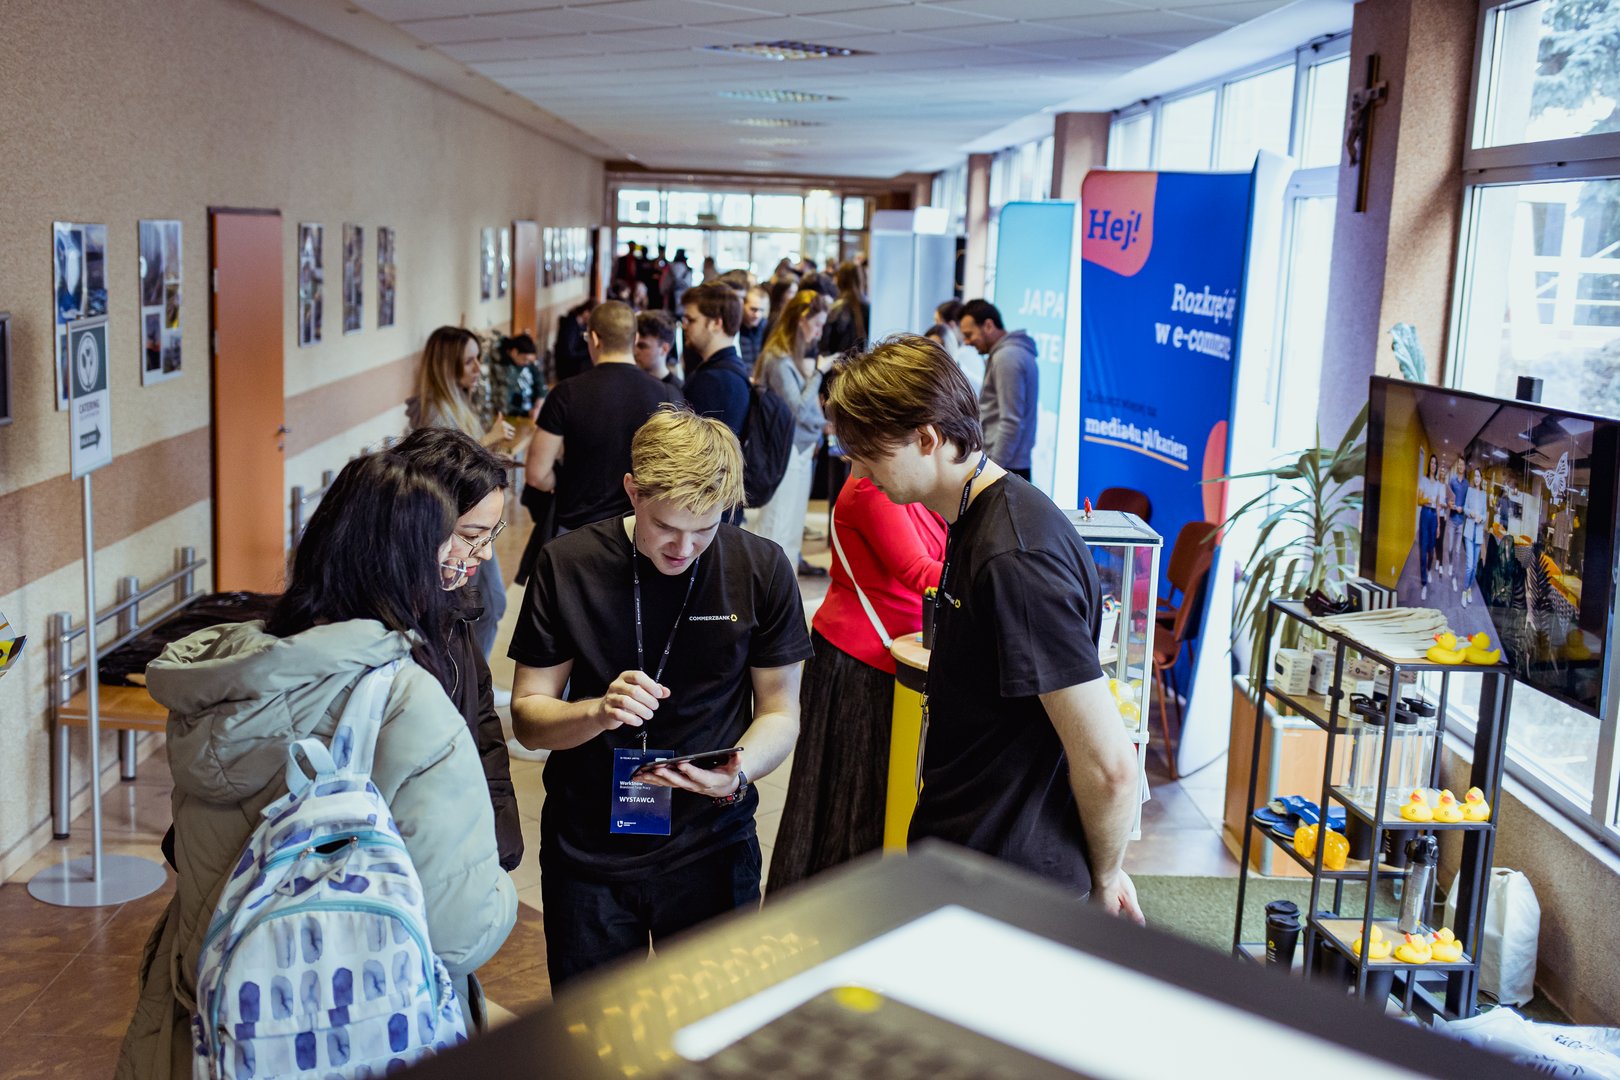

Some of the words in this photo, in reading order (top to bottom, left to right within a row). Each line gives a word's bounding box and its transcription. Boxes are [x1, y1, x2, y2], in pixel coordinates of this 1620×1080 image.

[1087, 209, 1142, 250] Hej!
[1155, 322, 1171, 345] w
[1033, 333, 1063, 363] TE
[79, 399, 100, 415] CATERING
[619, 796, 655, 804] WYSTAWCA
